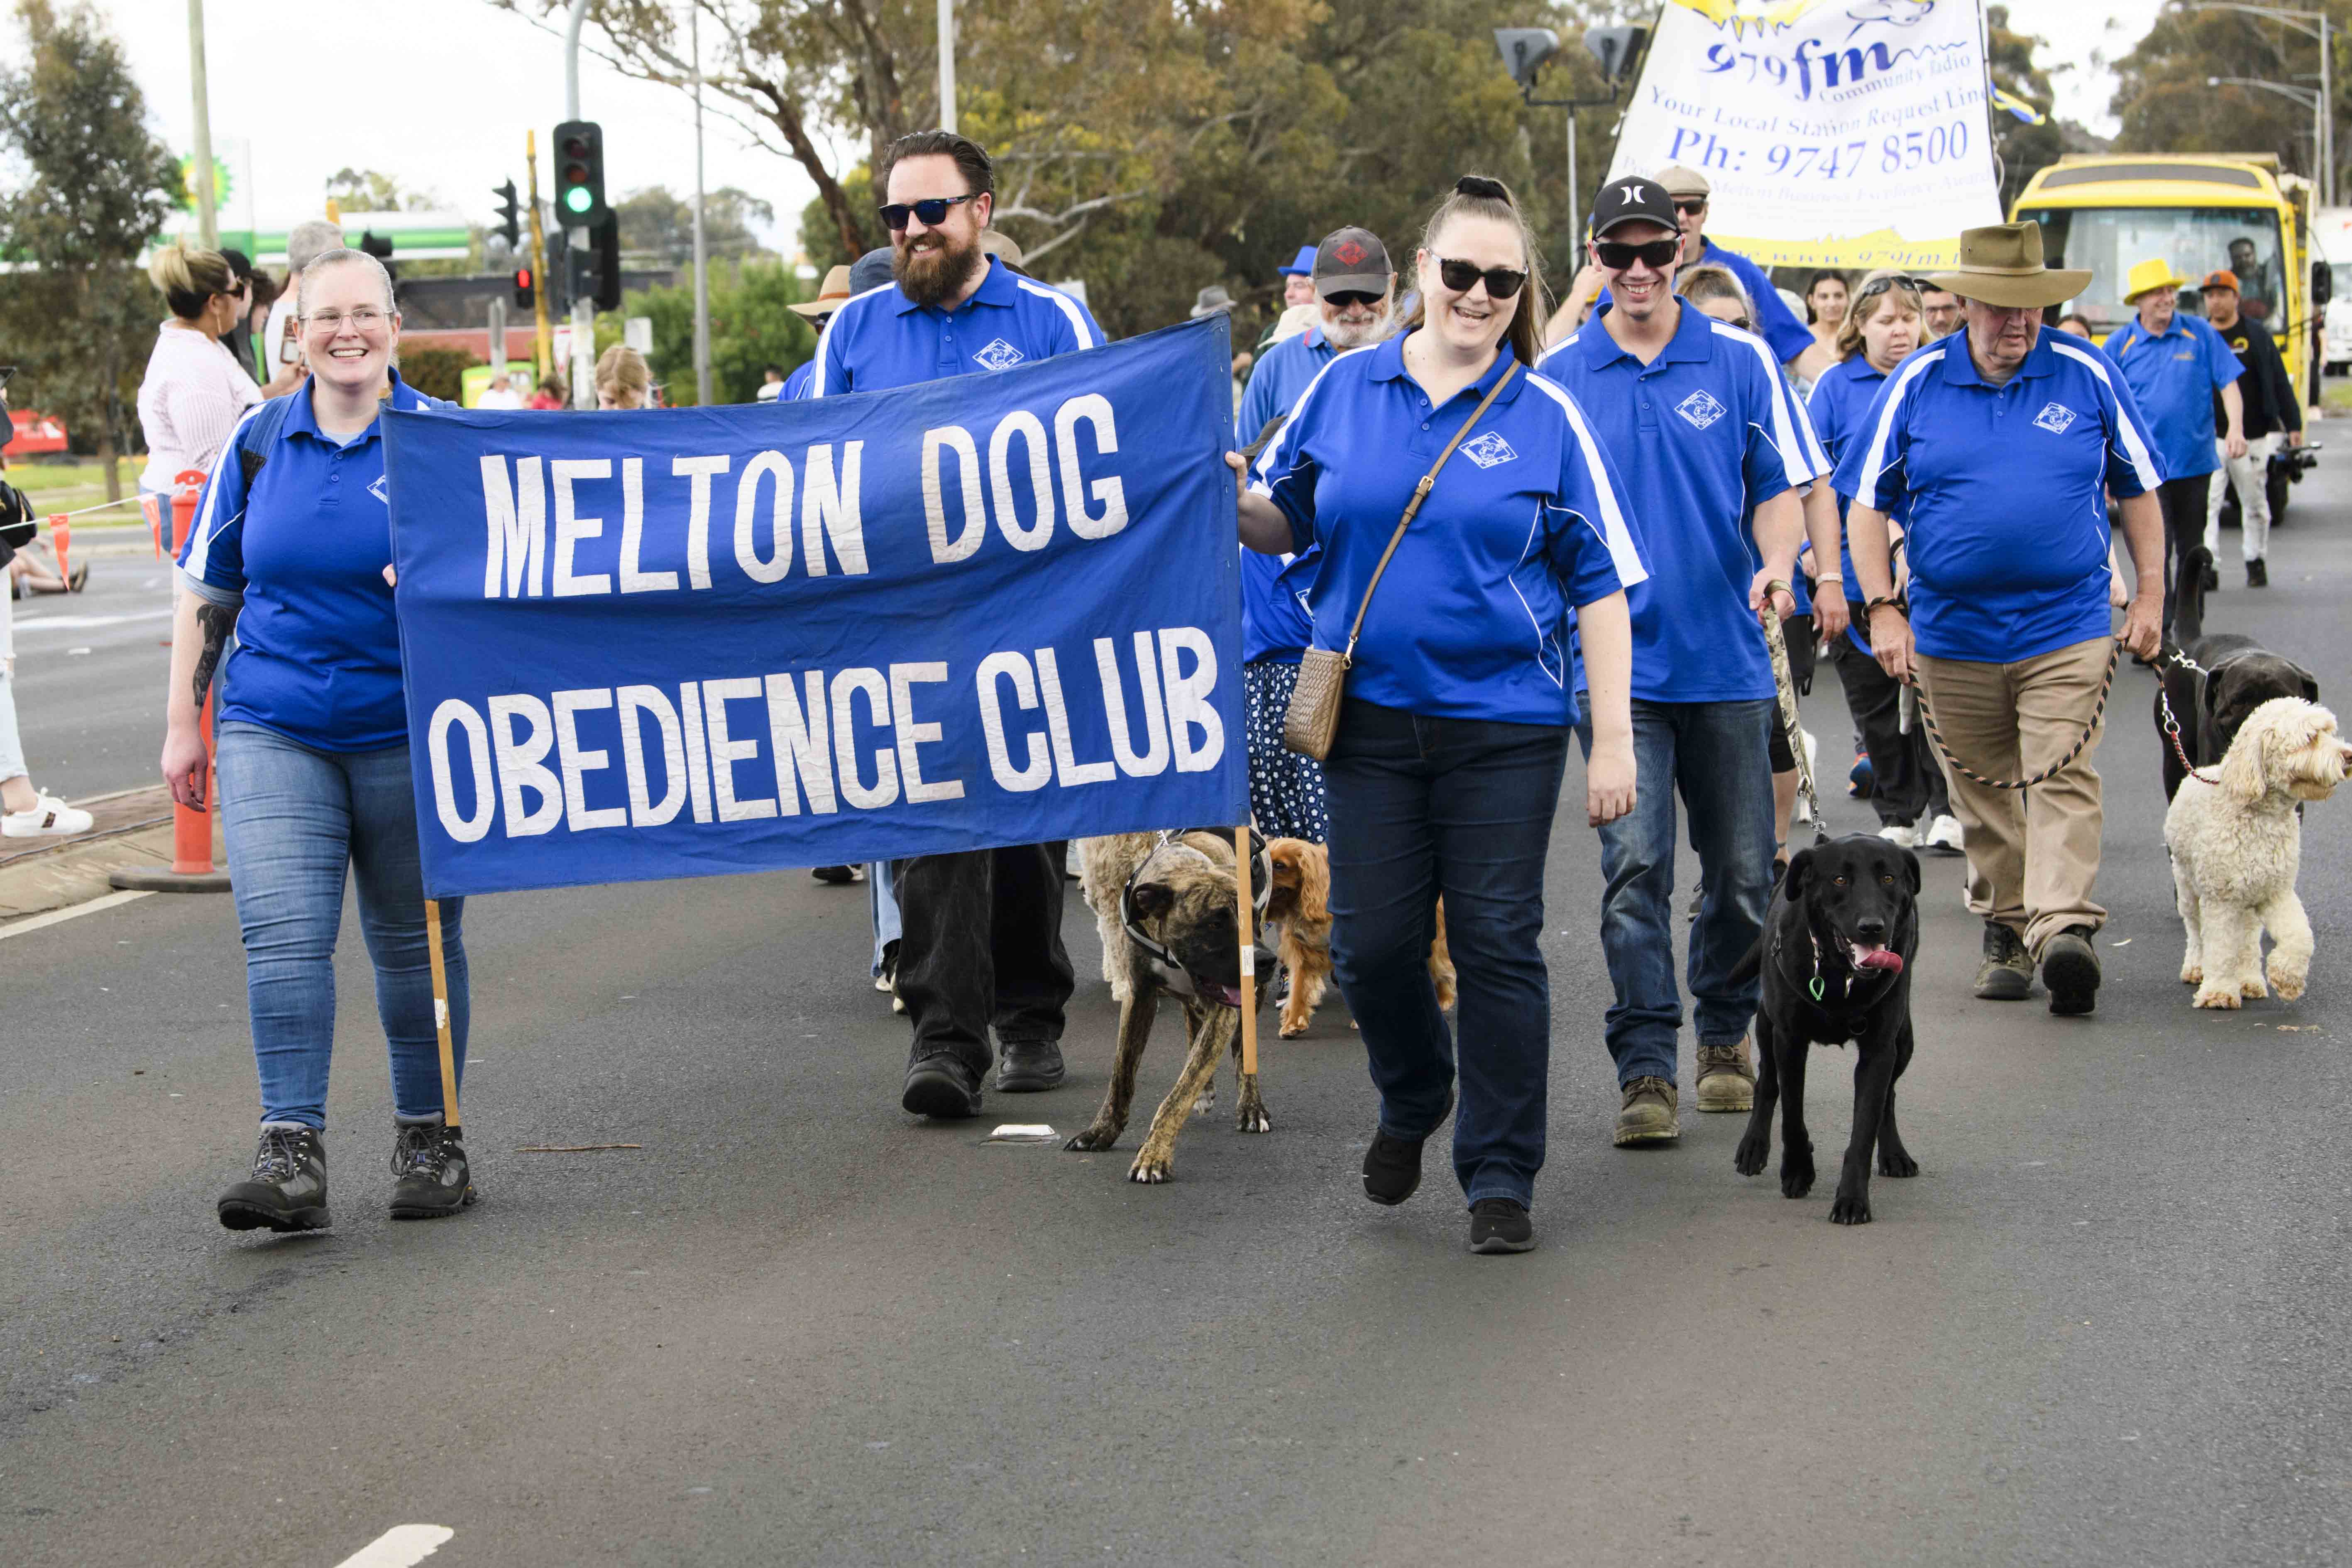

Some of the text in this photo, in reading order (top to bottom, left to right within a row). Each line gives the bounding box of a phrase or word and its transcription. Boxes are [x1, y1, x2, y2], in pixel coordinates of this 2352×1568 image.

[1697, 39, 1894, 101] 979fm
[1819, 66, 1924, 103] Community
[1653, 84, 1706, 118] Your
[1714, 106, 1778, 132] Local
[1866, 95, 1939, 128] Request
[1665, 120, 1968, 179] Ph: 9747 8500
[480, 393, 1128, 598] MELTON DOG
[428, 627, 1224, 842] OBEDIENCE CLUB
